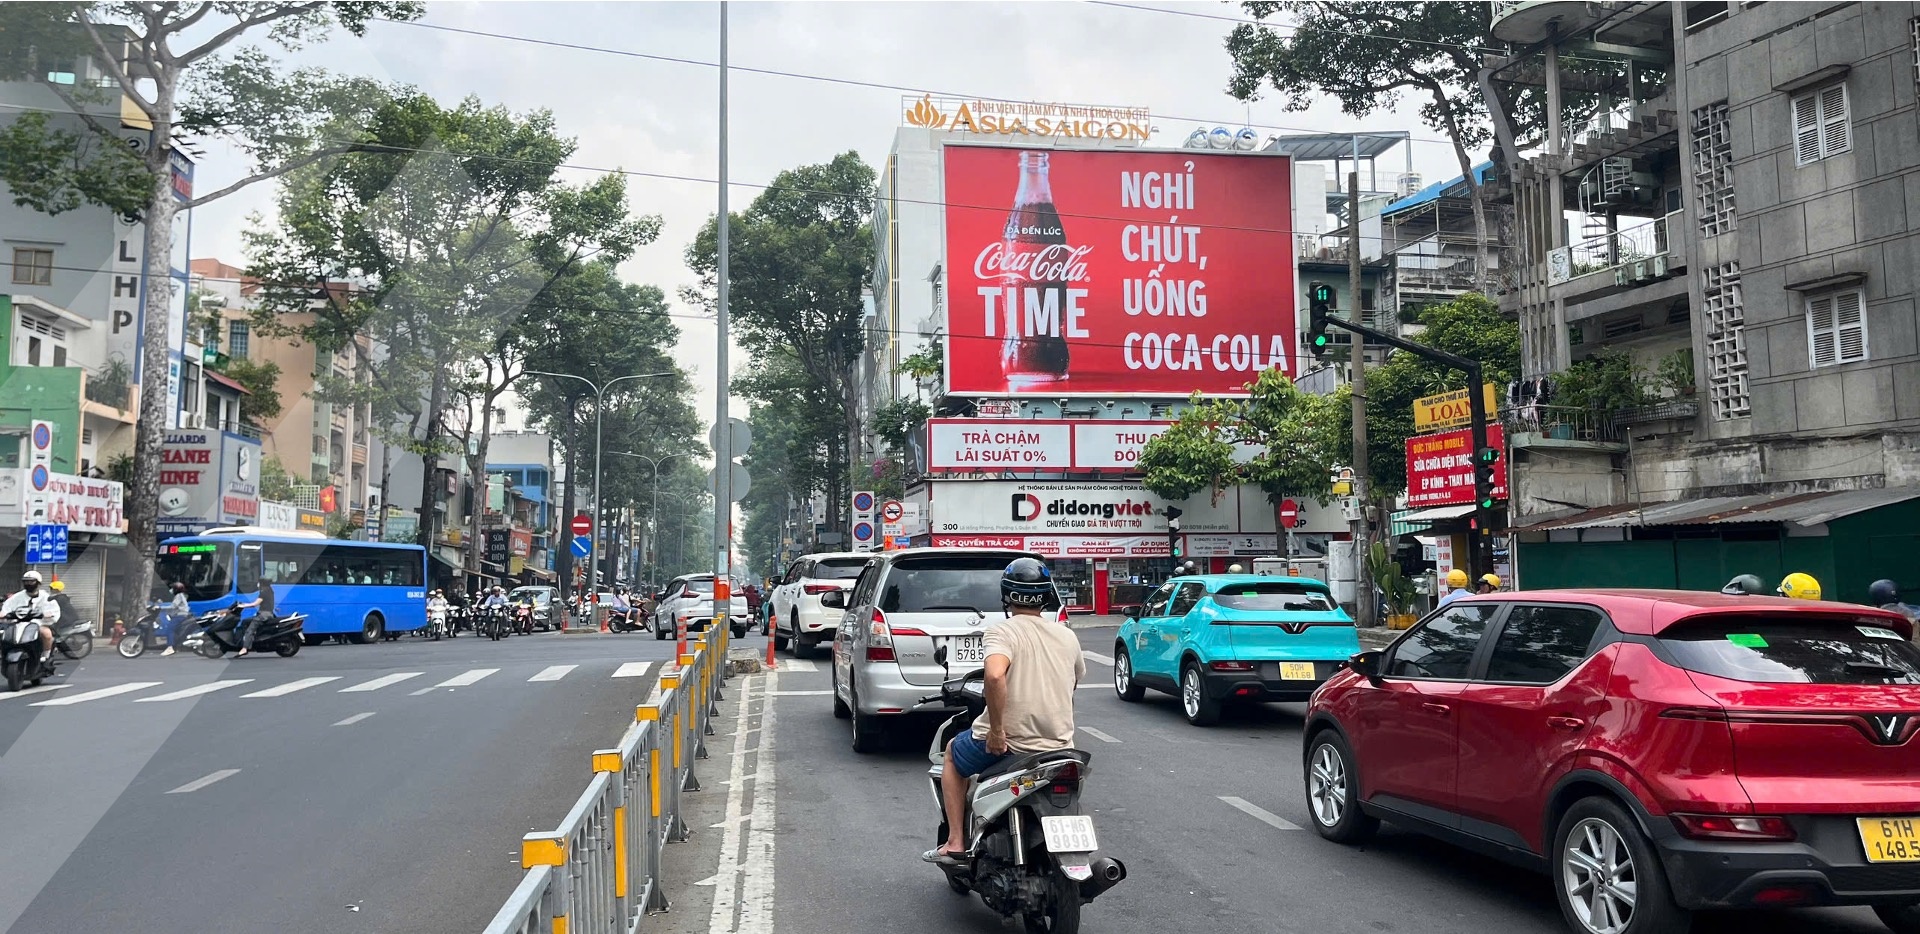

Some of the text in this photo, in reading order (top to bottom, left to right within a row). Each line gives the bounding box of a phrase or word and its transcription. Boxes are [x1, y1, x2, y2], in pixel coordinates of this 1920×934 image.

[1034, 117, 1149, 141] SAIGON
[1121, 160, 1195, 210] NGHỈ
[1022, 225, 1041, 235] ĐẾN
[1043, 226, 1061, 236] LÚC
[1121, 215, 1208, 270] CHÚT,
[1123, 263, 1207, 318] UỐNG
[977, 286, 1090, 338] TIME
[1124, 332, 1289, 372] COCA-COLA
[962, 429, 1040, 448] TRẢ CHẬM
[1116, 433, 1146, 444] THU
[956, 447, 1047, 462] LÃI SUẤT 0%
[943, 523, 958, 531] 300
[1071, 519, 1086, 528] GIAO
[1010, 591, 1043, 604] CLEAR
[964, 637, 984, 648] 61A
[1289, 663, 1304, 671] 50H
[1880, 819, 1915, 838] 61H
[1053, 834, 1090, 849] 9898
